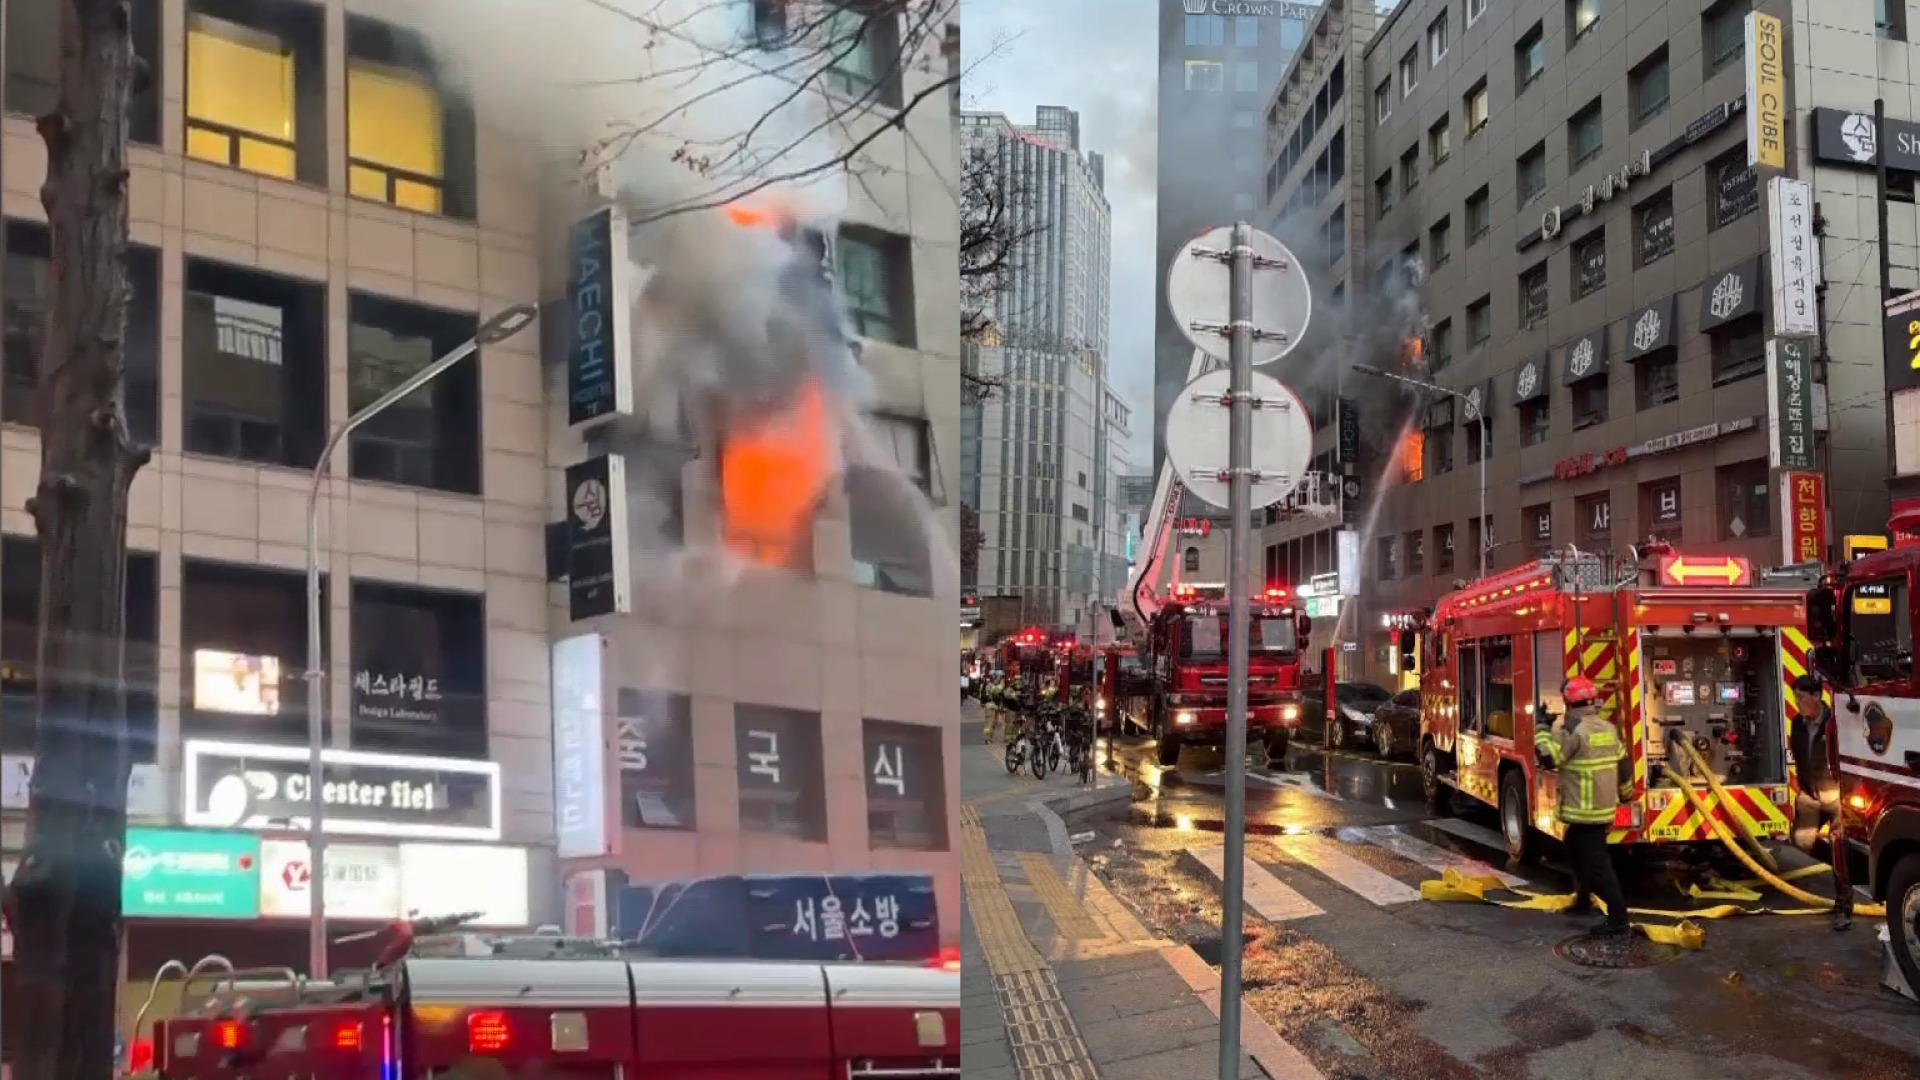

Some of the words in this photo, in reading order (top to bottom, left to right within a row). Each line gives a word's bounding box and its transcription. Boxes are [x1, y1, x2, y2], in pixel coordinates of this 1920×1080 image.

[1760, 20, 1777, 86] SEOUL
[1761, 93, 1779, 152] CUBE
[748, 729, 780, 784] 국
[873, 744, 905, 796] 식
[793, 895, 900, 941] 서울소방
